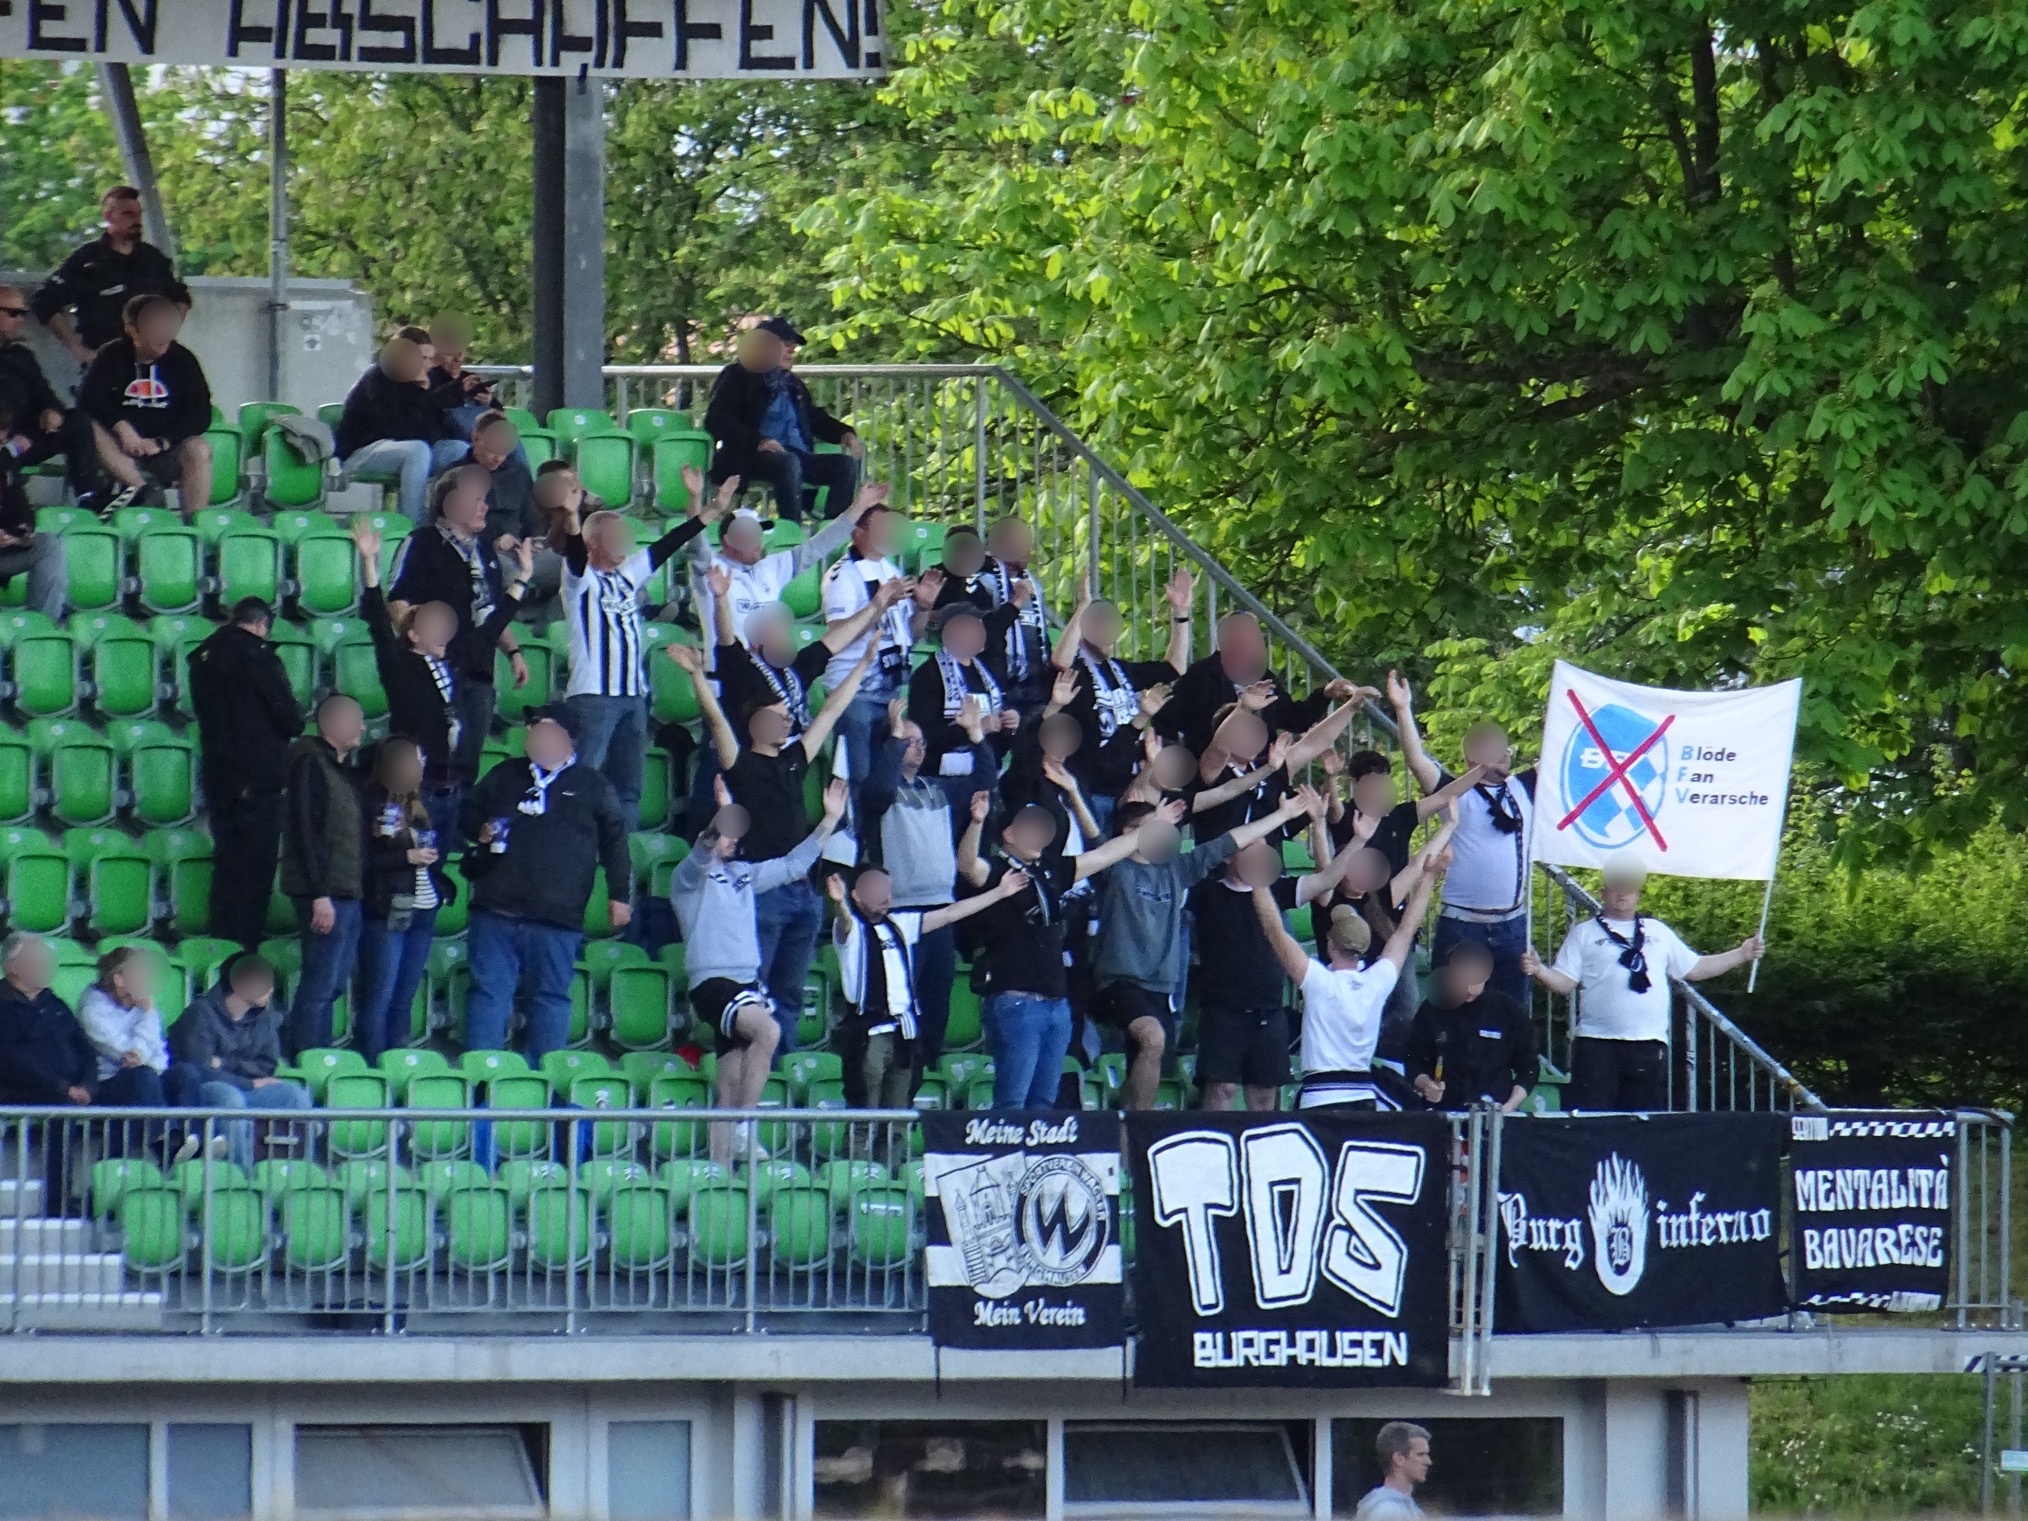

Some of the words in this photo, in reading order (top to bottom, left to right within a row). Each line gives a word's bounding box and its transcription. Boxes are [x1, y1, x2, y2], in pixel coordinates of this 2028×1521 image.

[0, 0, 155, 55] EN
[1681, 745, 1737, 763] Blöde
[1677, 766, 1714, 784] Fan
[1675, 788, 1769, 806] Verarsche
[965, 1118, 1024, 1145] Meine
[1025, 1115, 1078, 1147] Stadt
[1148, 1121, 1426, 1318] TDS
[1496, 1192, 1584, 1270] Burg
[1656, 1191, 1772, 1249] inferno
[1803, 1224, 1943, 1270] BAVARESE
[974, 1299, 1021, 1327] Mein
[1023, 1297, 1086, 1326] Verein
[1193, 1330, 1408, 1367] BURGHAUSEN
